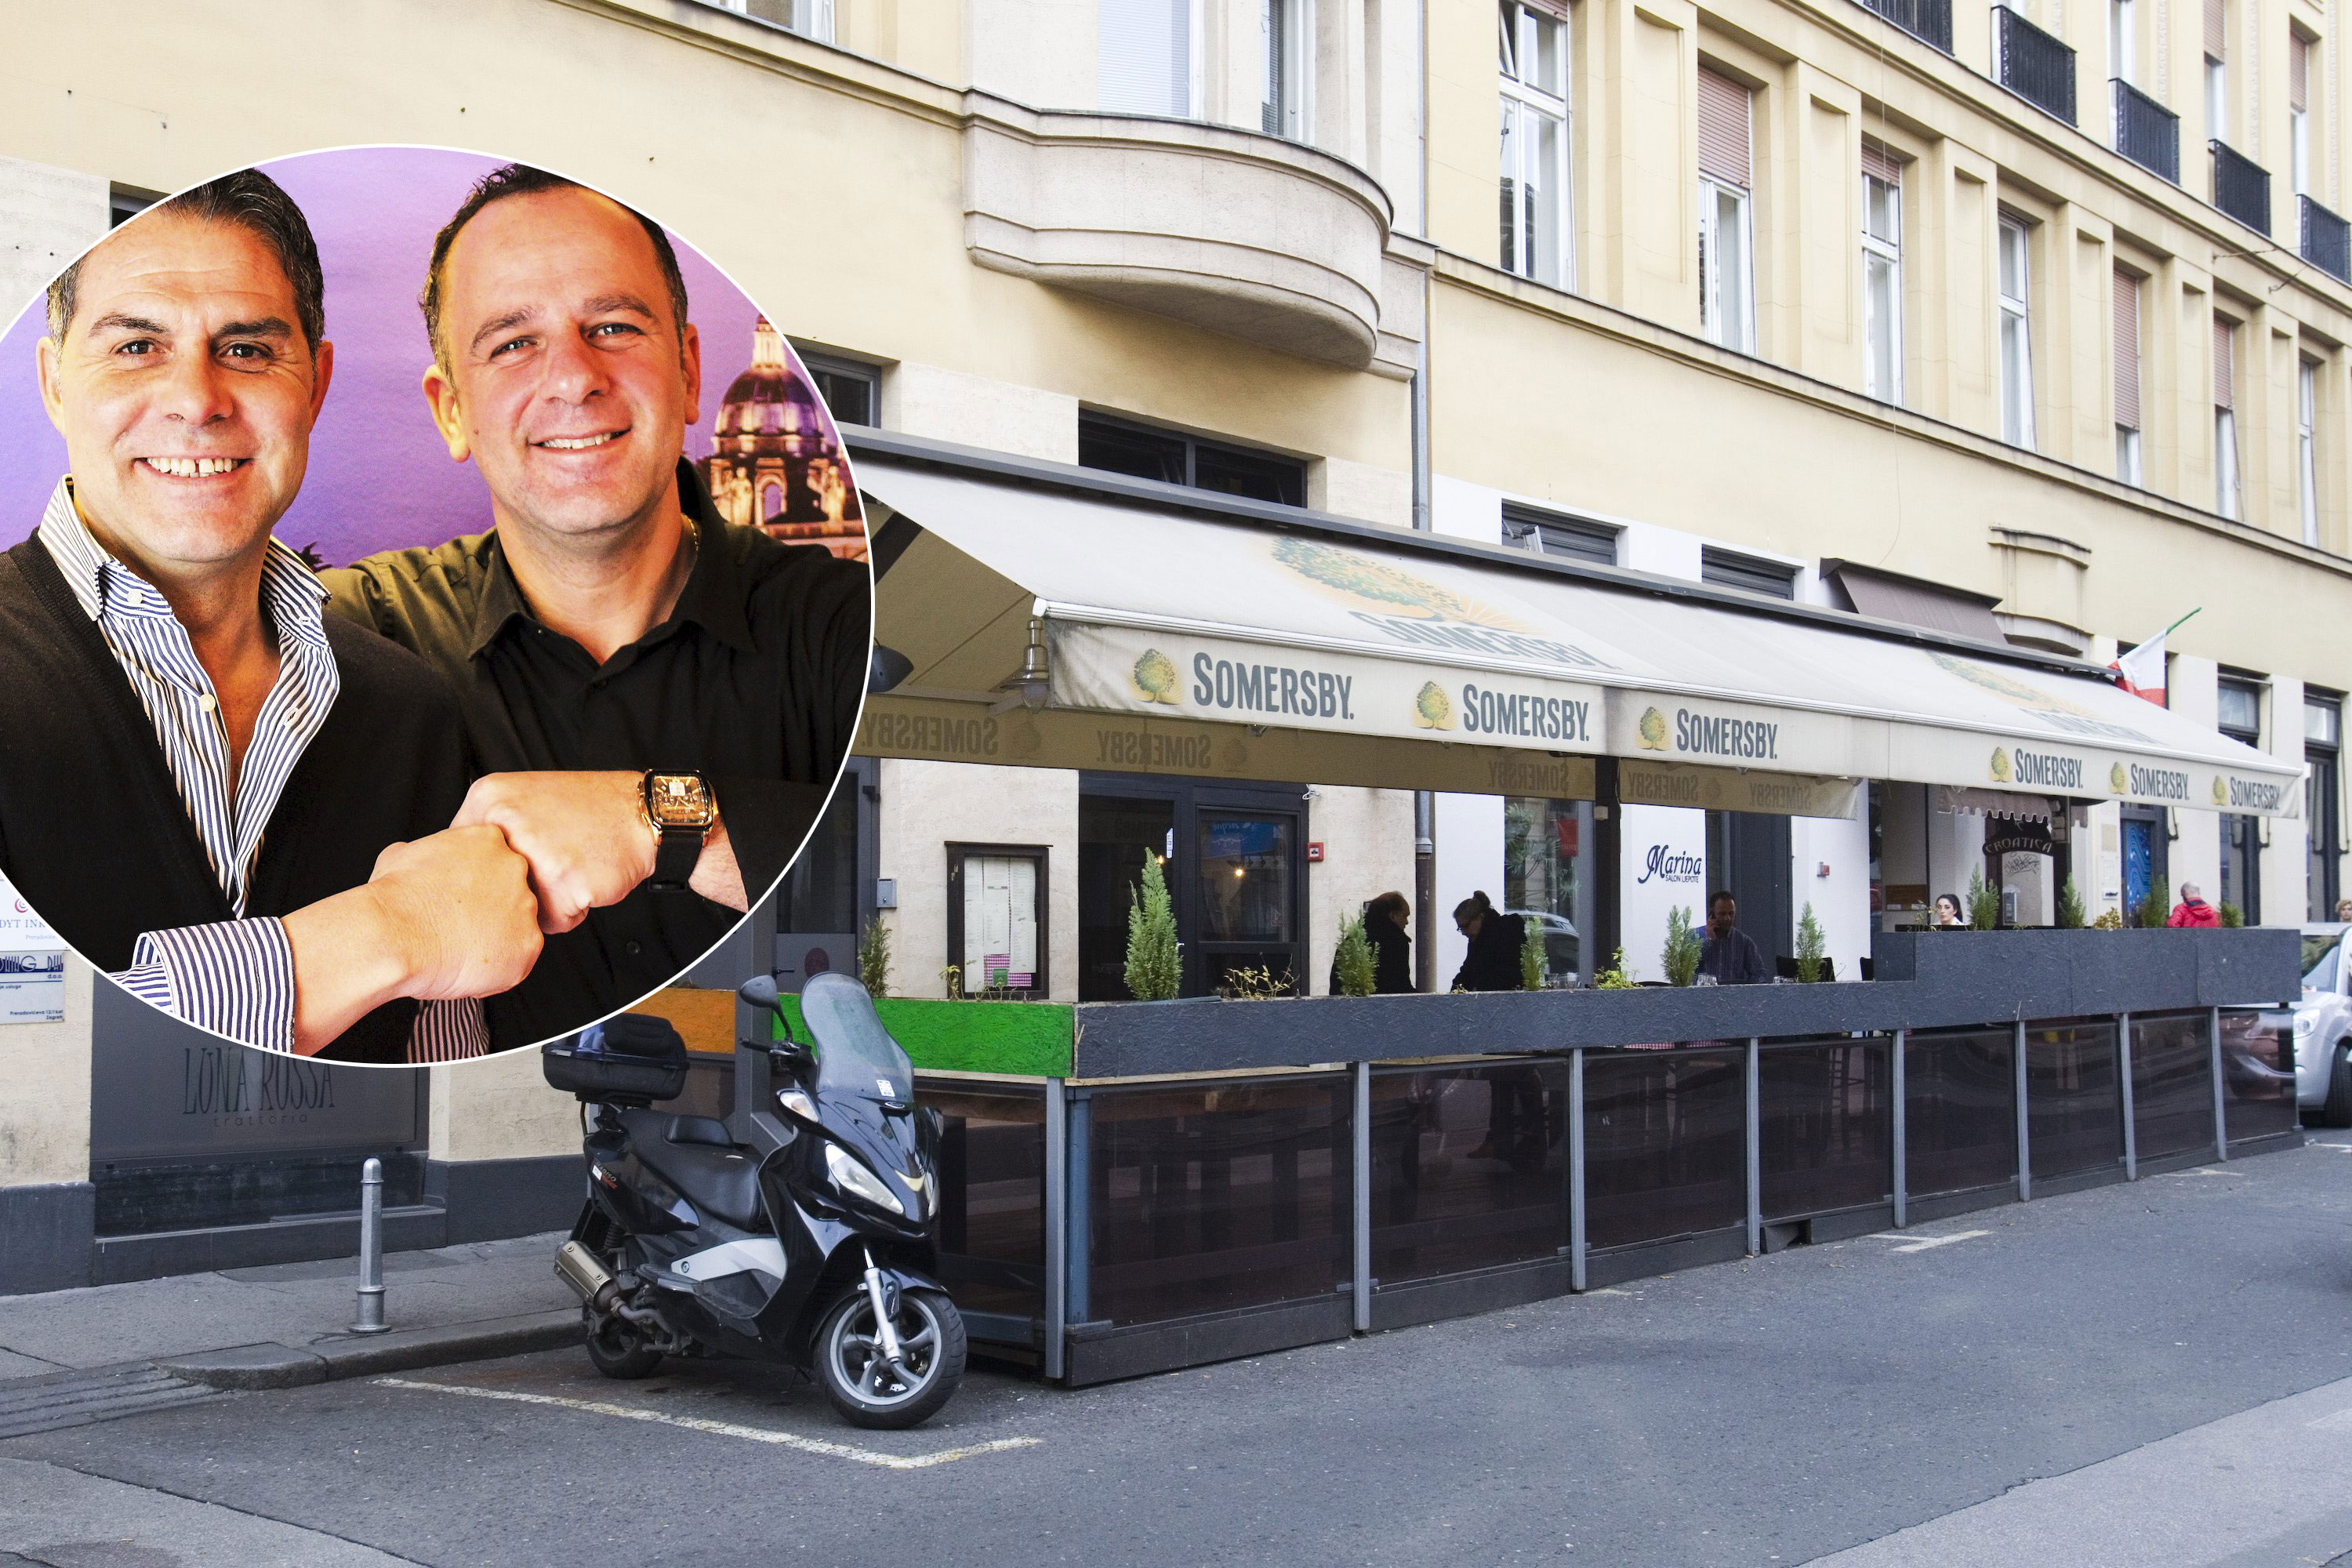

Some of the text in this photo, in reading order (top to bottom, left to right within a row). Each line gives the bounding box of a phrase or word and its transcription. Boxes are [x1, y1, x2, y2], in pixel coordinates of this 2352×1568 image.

[1193, 652, 1355, 720] SOMERSBY.
[1462, 684, 1590, 742] SOMERSBY.
[1676, 708, 1778, 760] SOMERSBY.
[2015, 748, 2083, 789] SOMERSBY.
[2130, 762, 2190, 800] SOMERSBY.
[1638, 844, 1702, 884] Marina
[1985, 837, 2053, 854] CROATICA
[213, 1113, 307, 1127] trattoria
